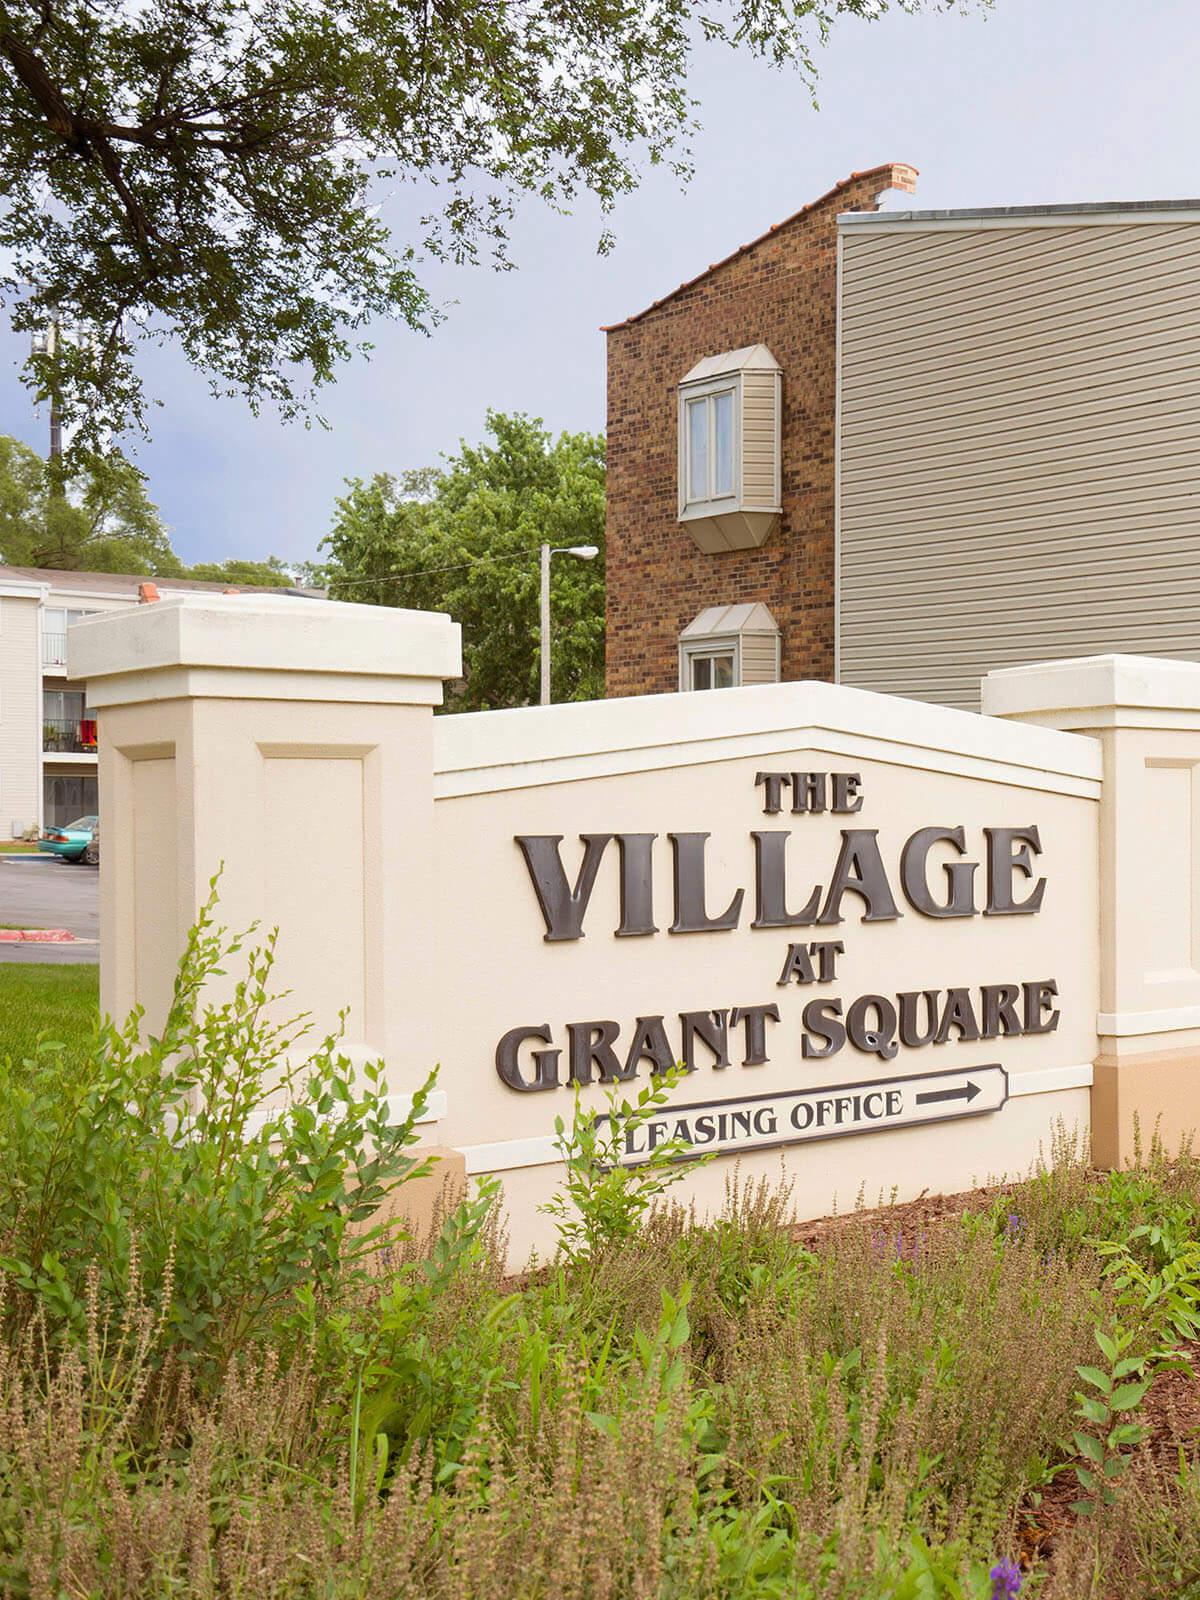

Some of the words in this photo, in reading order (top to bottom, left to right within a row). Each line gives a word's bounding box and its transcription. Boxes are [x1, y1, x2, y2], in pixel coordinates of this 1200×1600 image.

[754, 771, 864, 814] THE
[514, 825, 1048, 941] VILLAGE
[776, 940, 845, 985] AT
[495, 1003, 780, 1091] GRANT
[801, 978, 1061, 1060] SQUARE
[624, 1107, 778, 1155] LEASING
[790, 1090, 904, 1130] OFFICE
